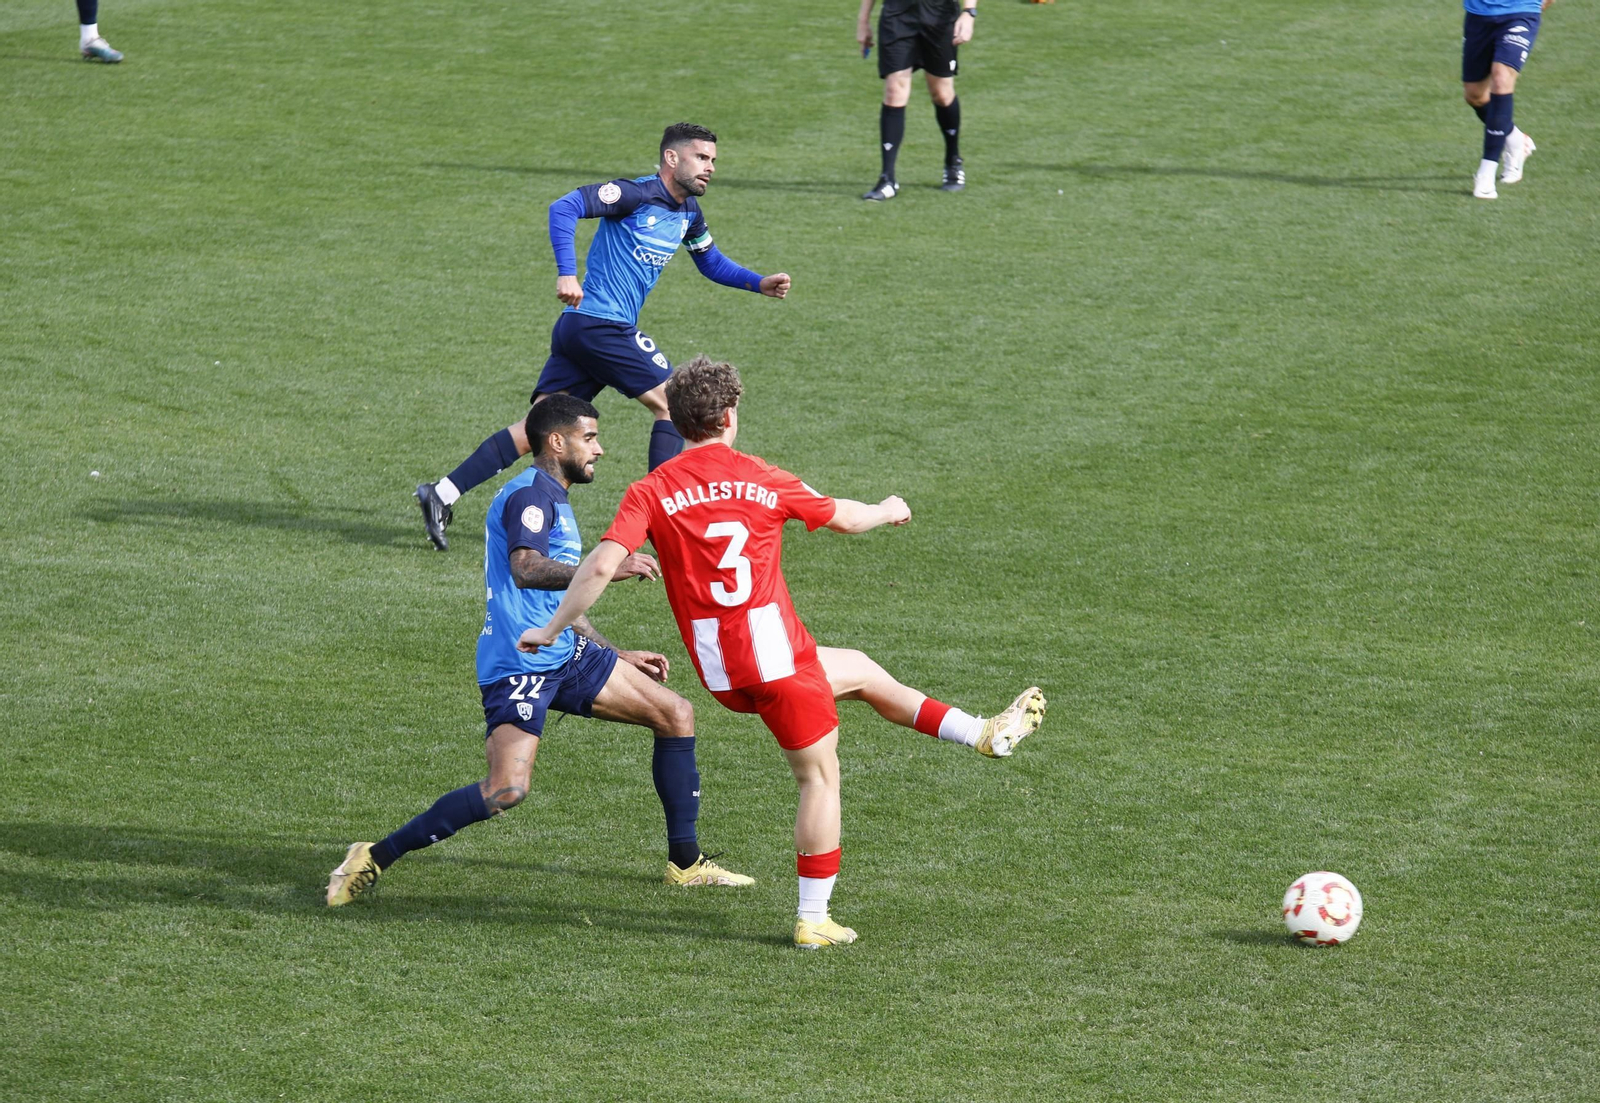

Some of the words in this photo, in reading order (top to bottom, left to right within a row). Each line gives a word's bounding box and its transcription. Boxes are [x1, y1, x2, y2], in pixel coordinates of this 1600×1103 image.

[635, 331, 656, 353] 6
[661, 481, 778, 516] BALLESTERO
[703, 521, 753, 607] 3
[508, 675, 546, 700] 22
